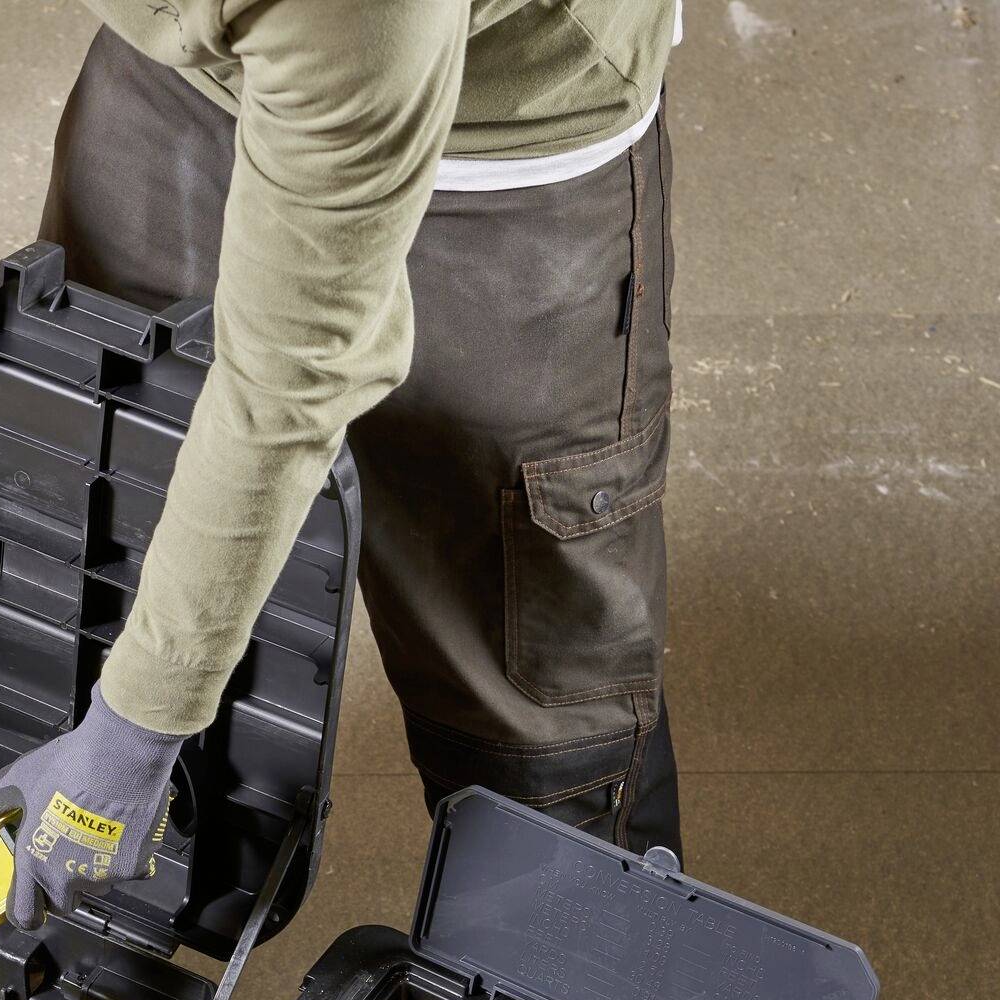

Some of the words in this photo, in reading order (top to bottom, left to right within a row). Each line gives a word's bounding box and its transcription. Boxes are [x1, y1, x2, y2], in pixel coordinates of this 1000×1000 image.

[53, 799, 117, 836] STANLEY
[686, 908, 738, 940] TABLE
[516, 963, 570, 995] QUARTS
